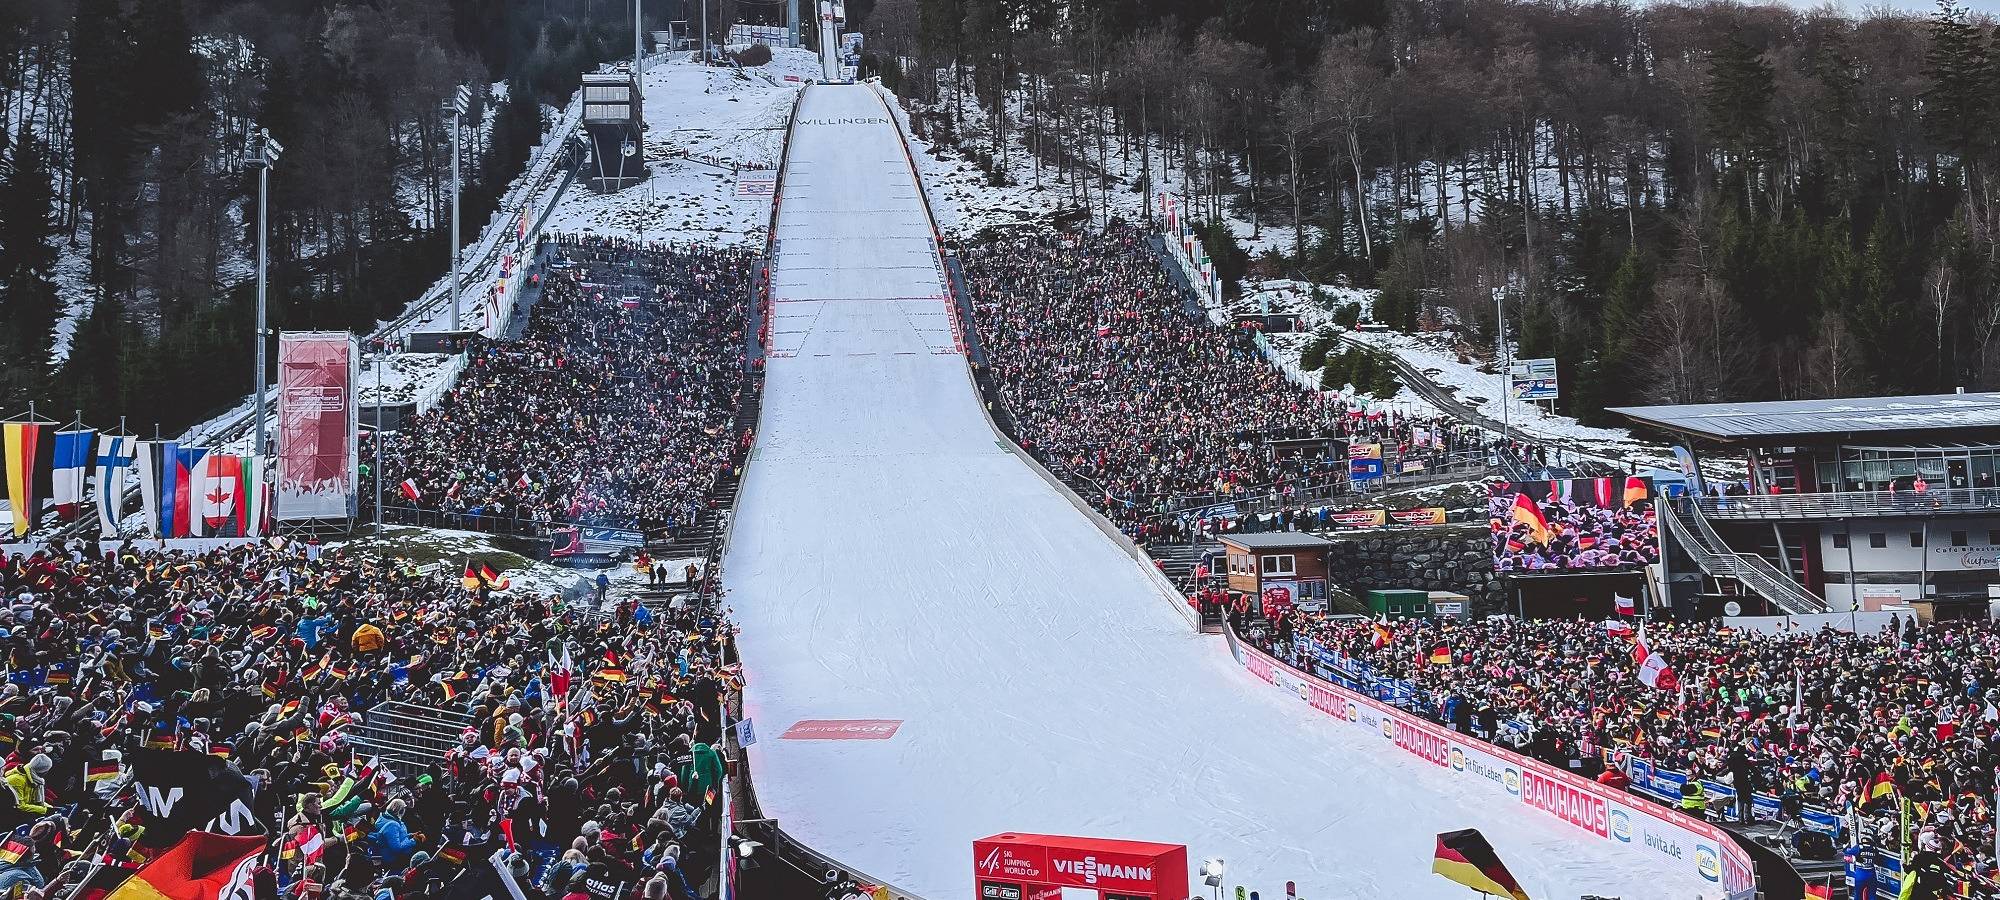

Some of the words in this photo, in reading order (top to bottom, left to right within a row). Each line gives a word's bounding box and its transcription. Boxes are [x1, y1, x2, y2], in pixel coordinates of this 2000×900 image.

[1309, 686, 1347, 720] BAUHAUS
[1395, 721, 1448, 765] BAUHAUS
[1473, 759, 1483, 778] fürs
[1524, 775, 1607, 832] BAUHAUS
[1644, 828, 1682, 860] lavita.de
[1003, 850, 1012, 858] SKI
[1003, 858, 1031, 868] JUMPING
[1004, 866, 1025, 876] WORLD
[1026, 867, 1039, 877] CUP
[1053, 856, 1152, 884] VIESSMANN
[586, 878, 616, 894] atlas
[985, 887, 997, 896] Grill
[1002, 889, 1018, 898] Fürst
